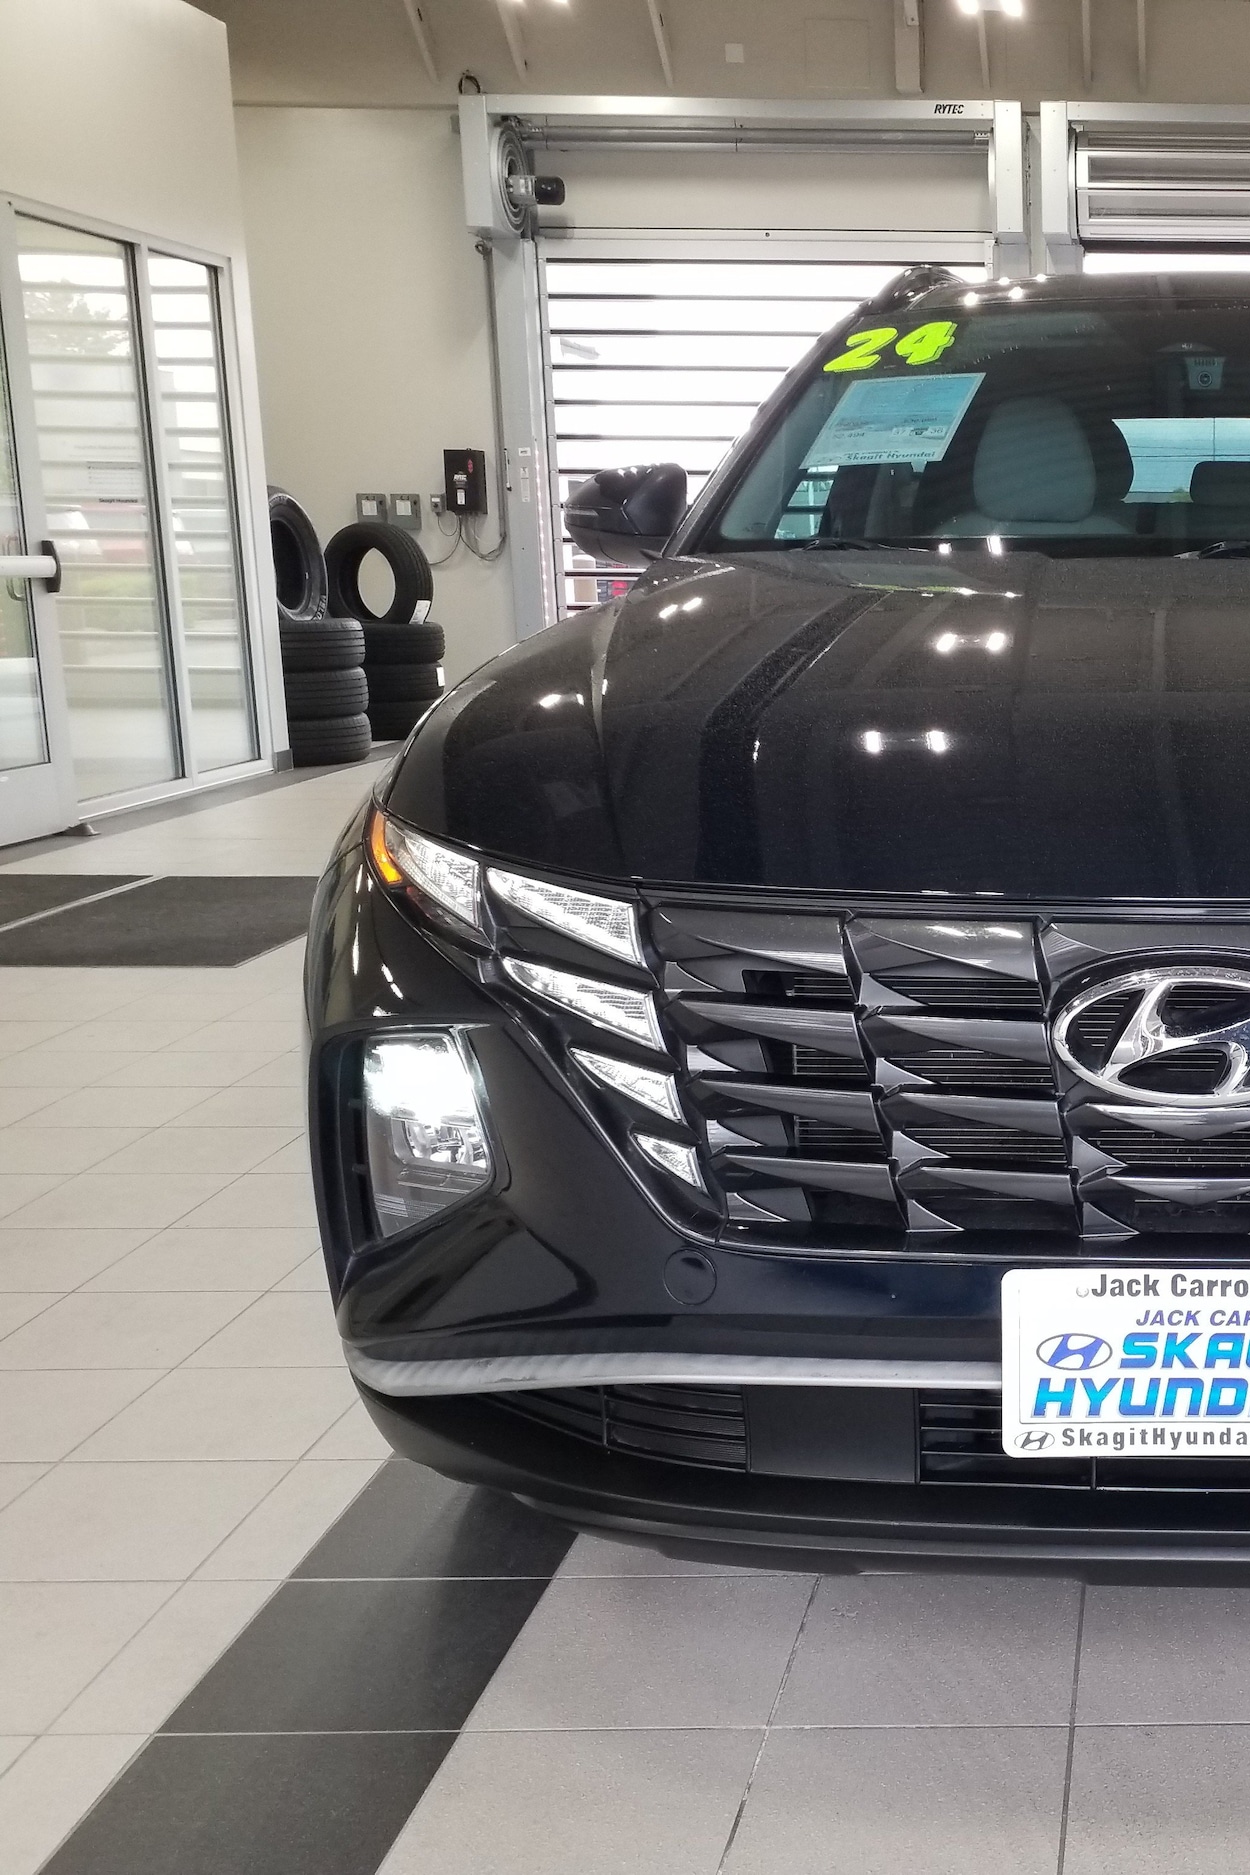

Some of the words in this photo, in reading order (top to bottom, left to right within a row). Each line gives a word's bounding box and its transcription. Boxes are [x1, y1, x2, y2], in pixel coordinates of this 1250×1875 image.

[934, 103, 965, 114] RYTEC
[823, 321, 958, 372] 24
[1091, 1273, 1160, 1298] Jack
[1136, 1309, 1201, 1327] JACK
